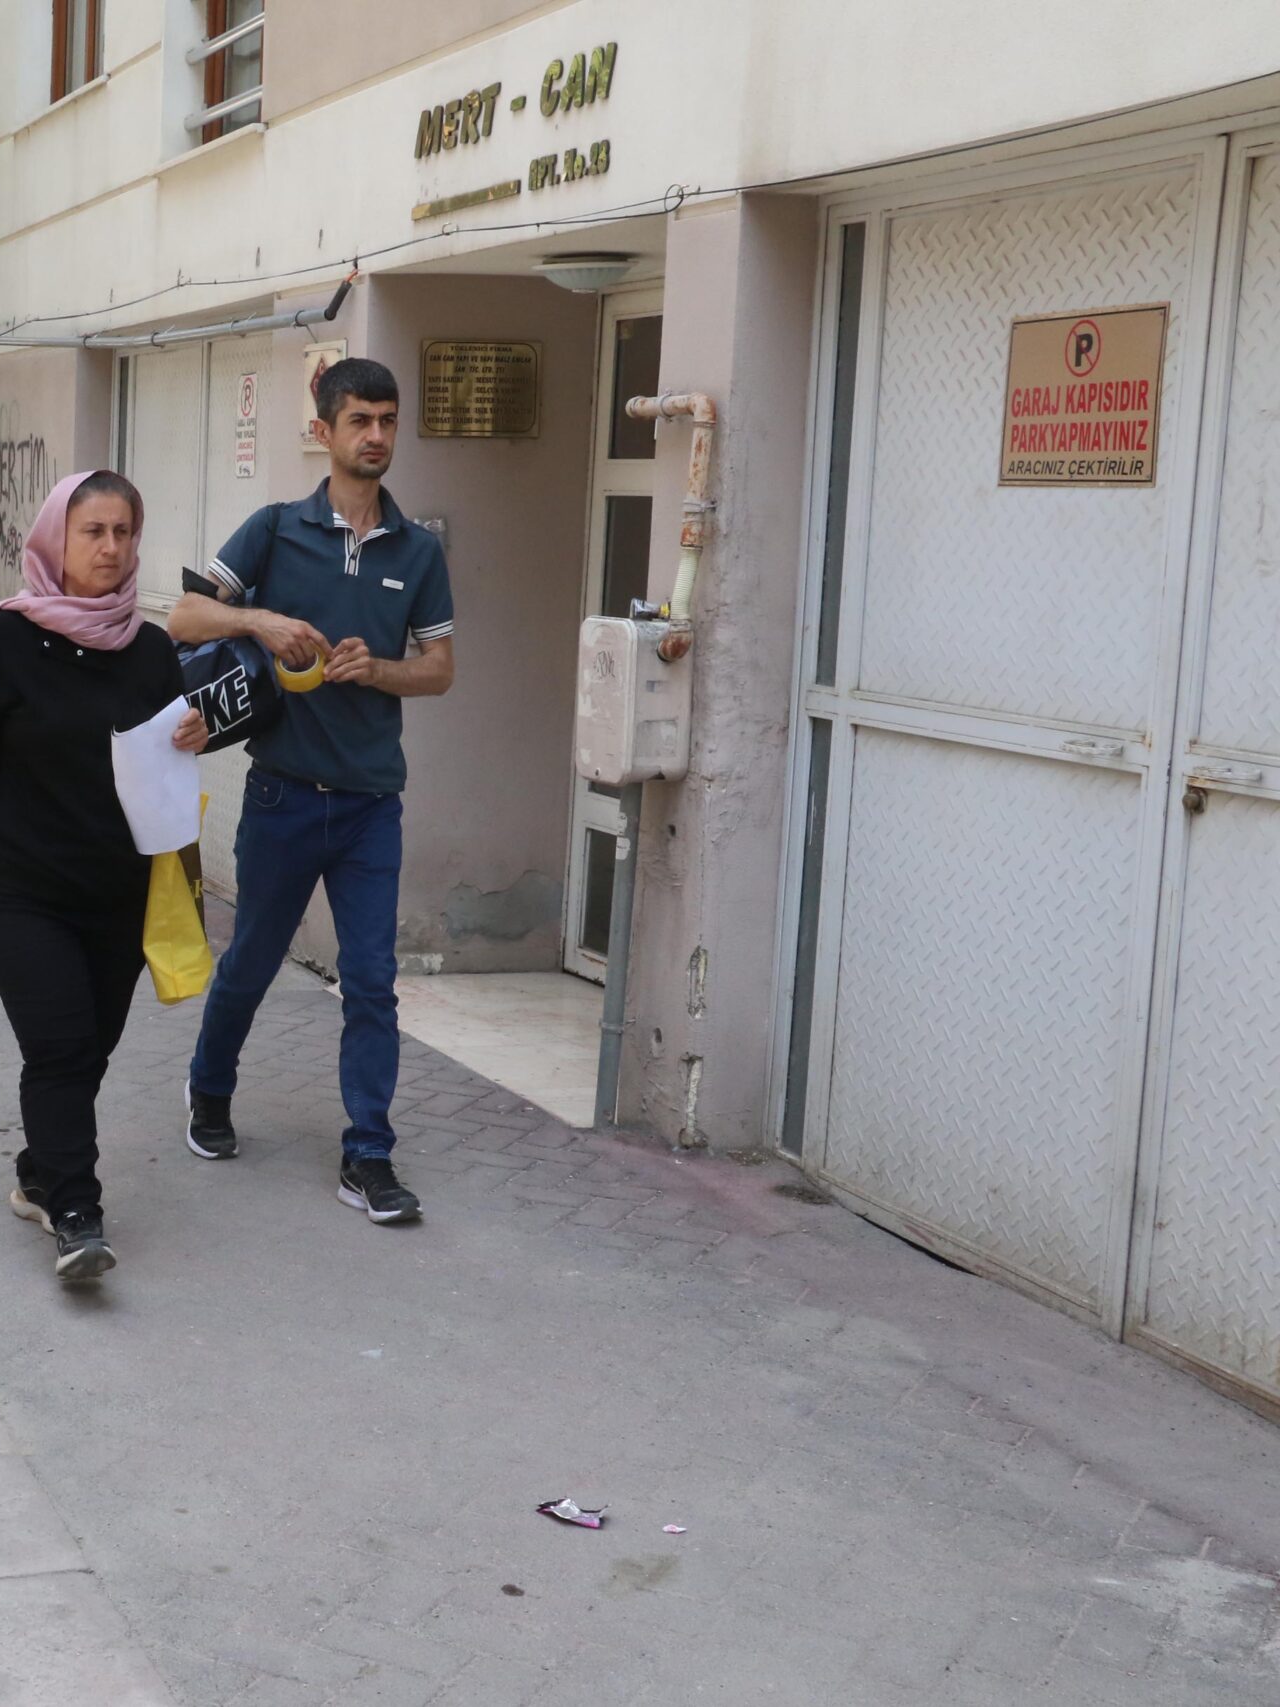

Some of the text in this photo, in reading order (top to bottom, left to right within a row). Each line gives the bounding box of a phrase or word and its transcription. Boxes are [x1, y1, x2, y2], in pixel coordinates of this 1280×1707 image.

[414, 82, 502, 159] MERT
[540, 42, 618, 117] CAN
[1011, 380, 1149, 417] GARAJ KAPISIDIR
[1007, 456, 1145, 478] ARACINIZ ÇEKTİRİLİR
